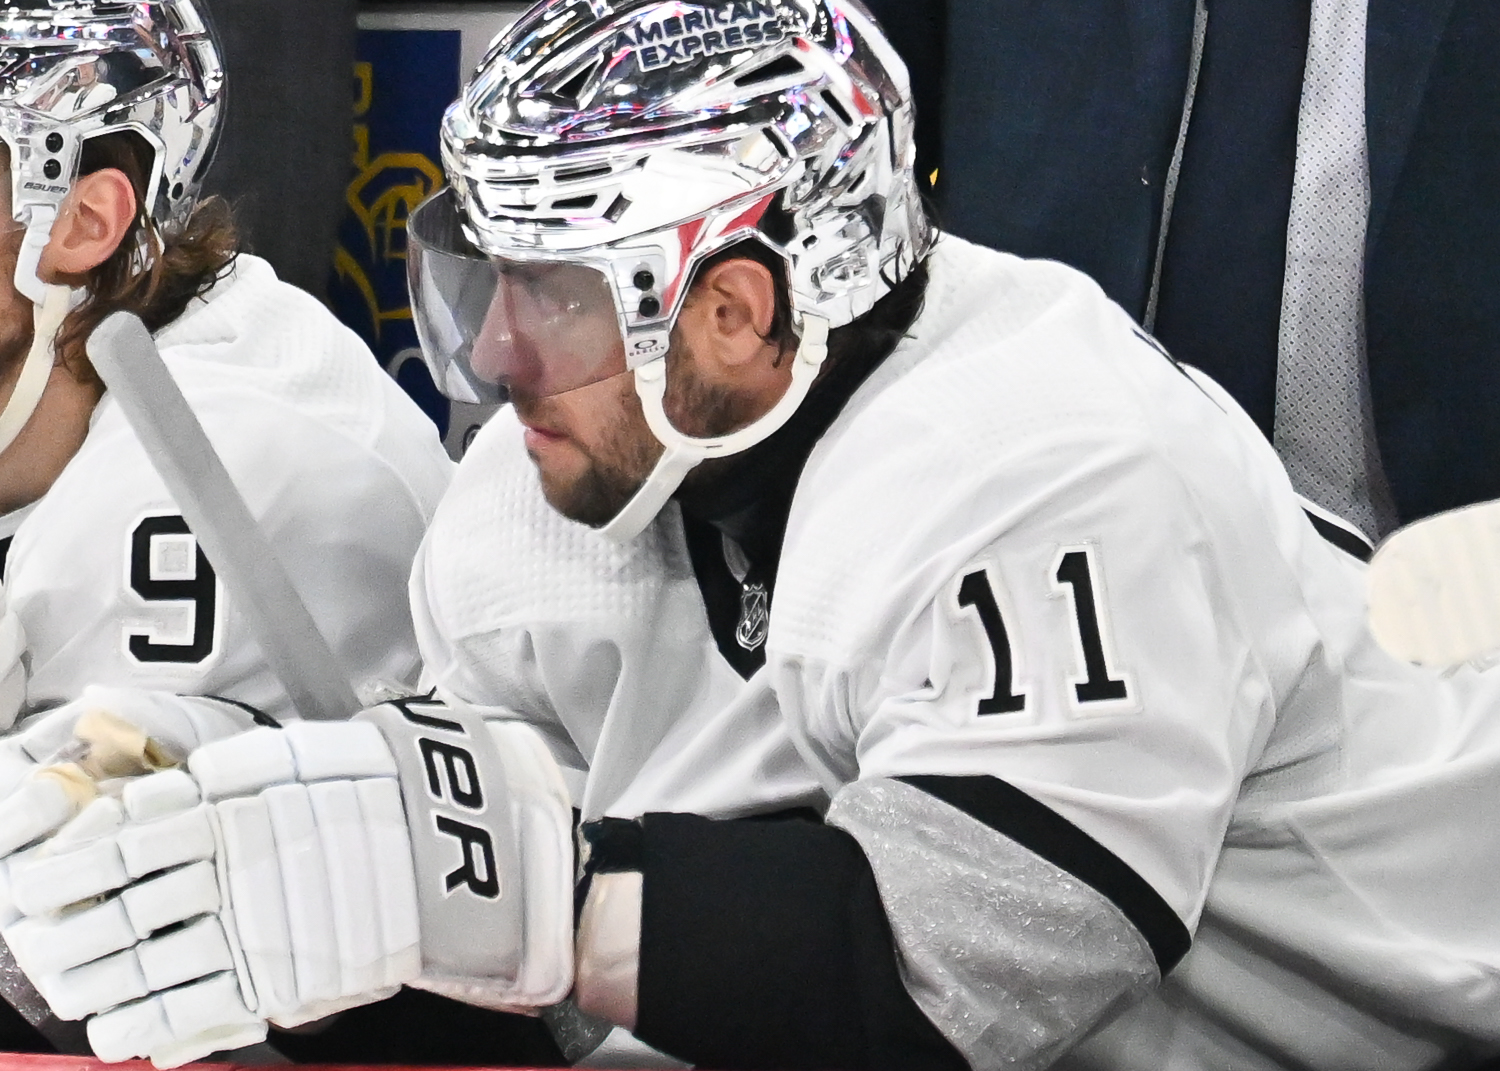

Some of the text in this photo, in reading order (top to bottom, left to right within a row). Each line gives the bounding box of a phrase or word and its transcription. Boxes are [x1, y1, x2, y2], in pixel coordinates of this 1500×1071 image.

[612, 0, 778, 50] AMERICAN
[638, 20, 785, 71] EXPRESS
[127, 512, 218, 666] 9
[955, 549, 1129, 718] 11
